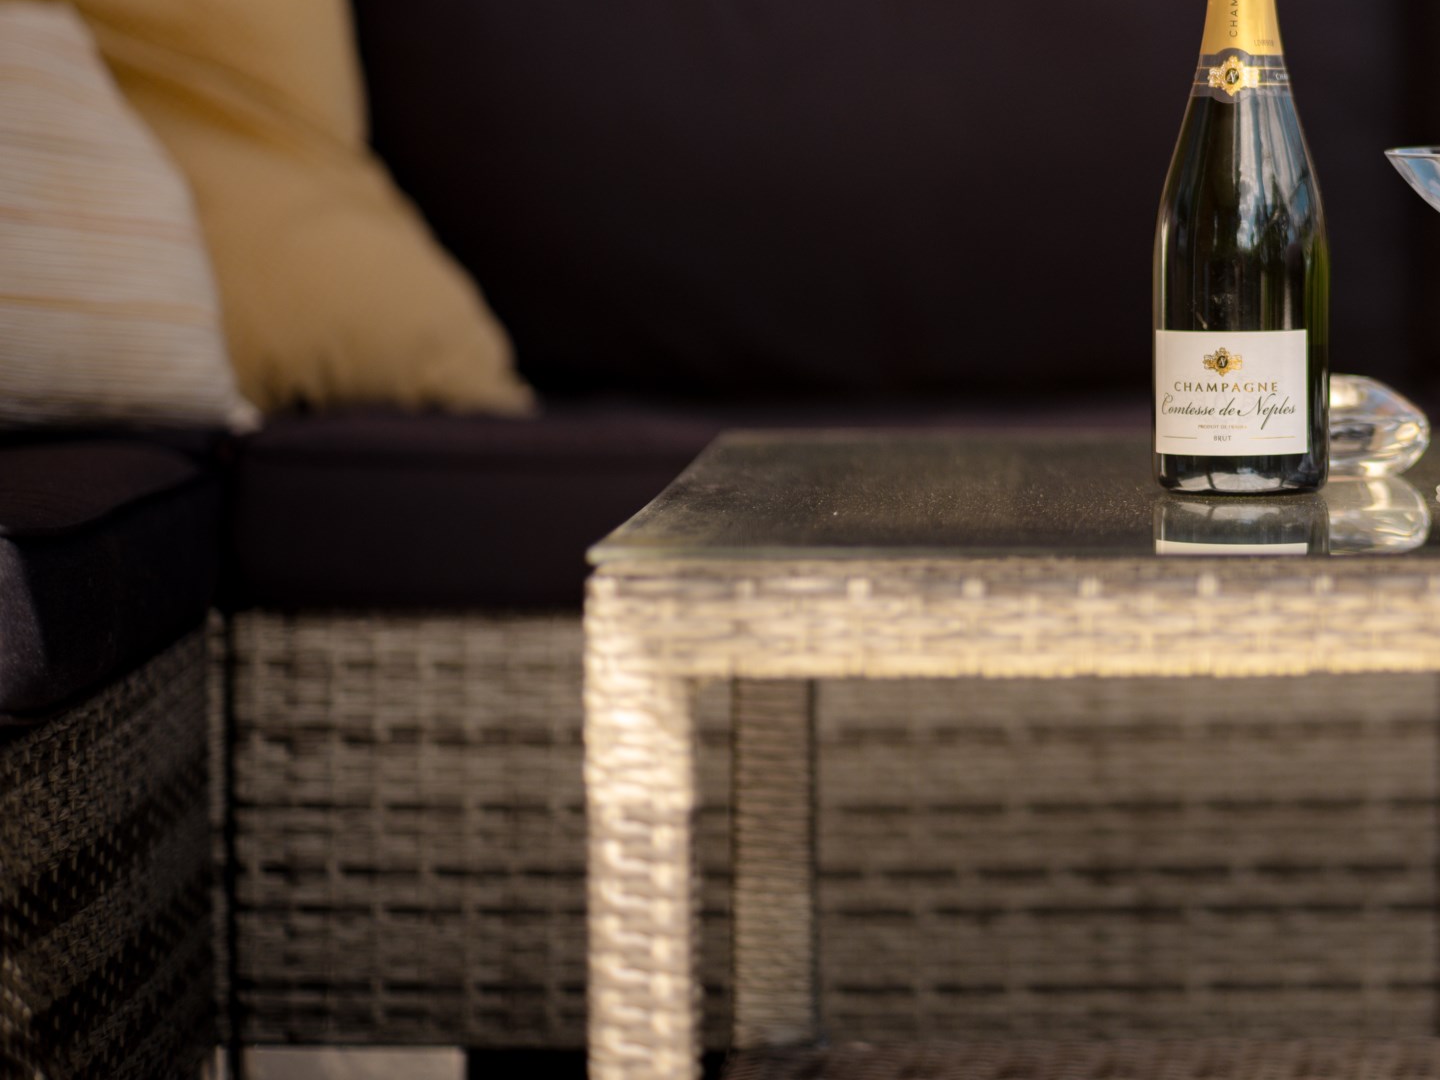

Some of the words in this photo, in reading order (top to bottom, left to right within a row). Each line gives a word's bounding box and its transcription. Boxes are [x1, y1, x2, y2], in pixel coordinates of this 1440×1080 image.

[1174, 381, 1278, 393] CHAMPAGNE
[1161, 393, 1215, 416] Comtesse
[1218, 397, 1236, 416] de
